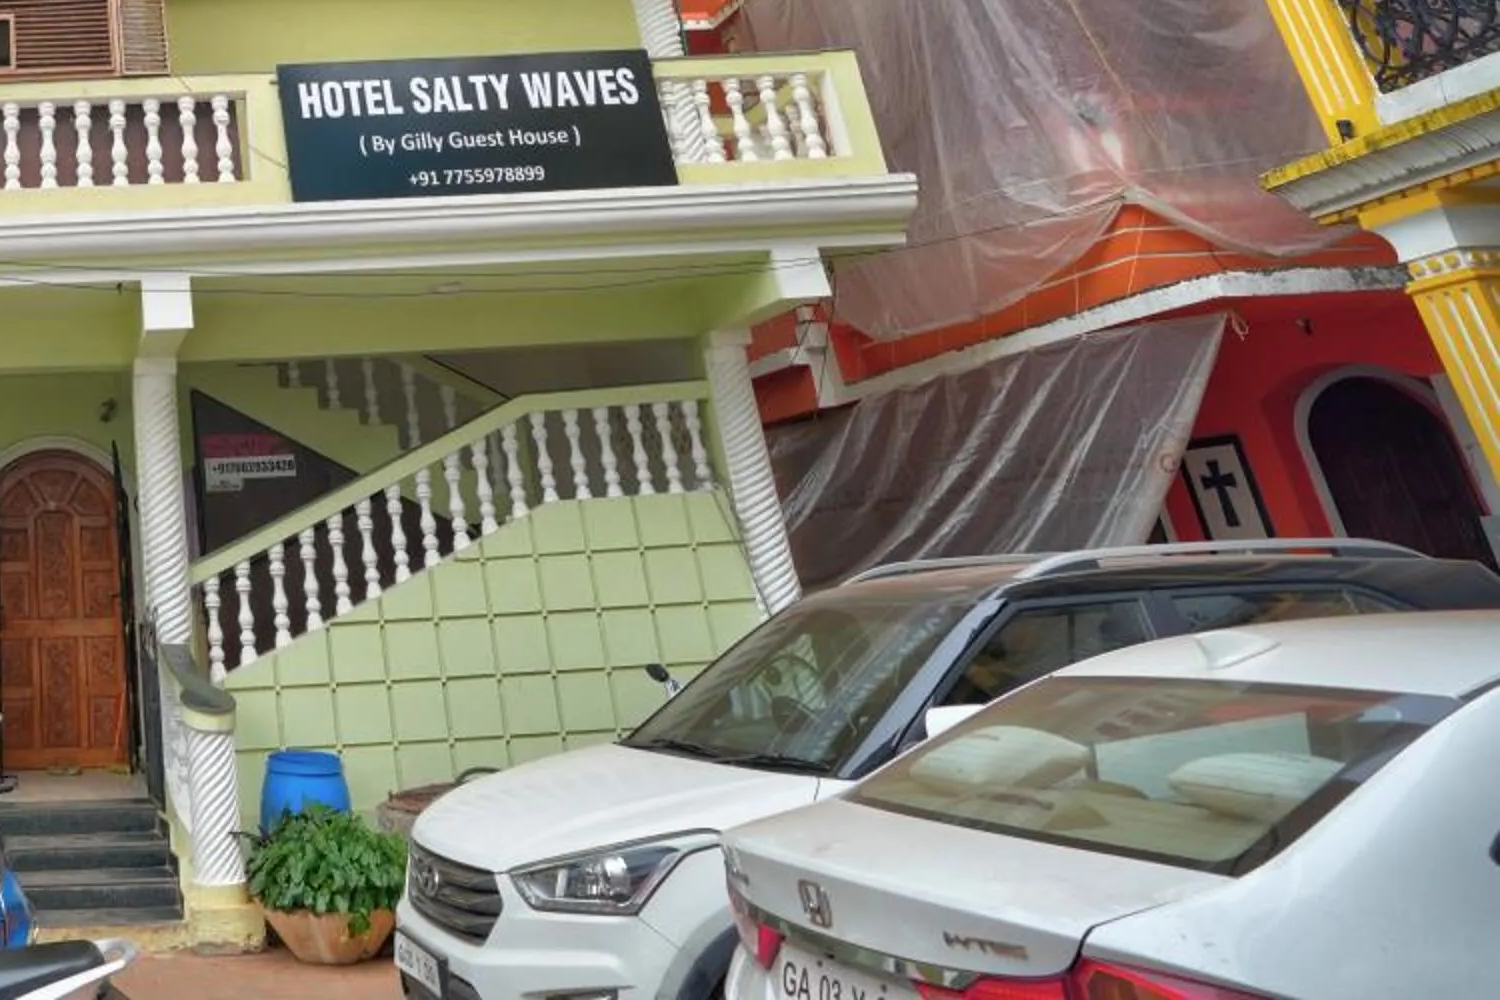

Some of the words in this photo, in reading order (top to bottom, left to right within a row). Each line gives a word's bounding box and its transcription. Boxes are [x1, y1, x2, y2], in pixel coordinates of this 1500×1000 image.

[298, 77, 404, 119] HOTEL
[409, 71, 509, 115] SALTY
[520, 67, 640, 109] WAVES
[400, 131, 444, 153] Gilly
[448, 130, 505, 150] Guest
[508, 128, 569, 146] House
[409, 170, 440, 187] +91
[443, 165, 546, 185] 7755978899
[782, 961, 811, 1000] GA
